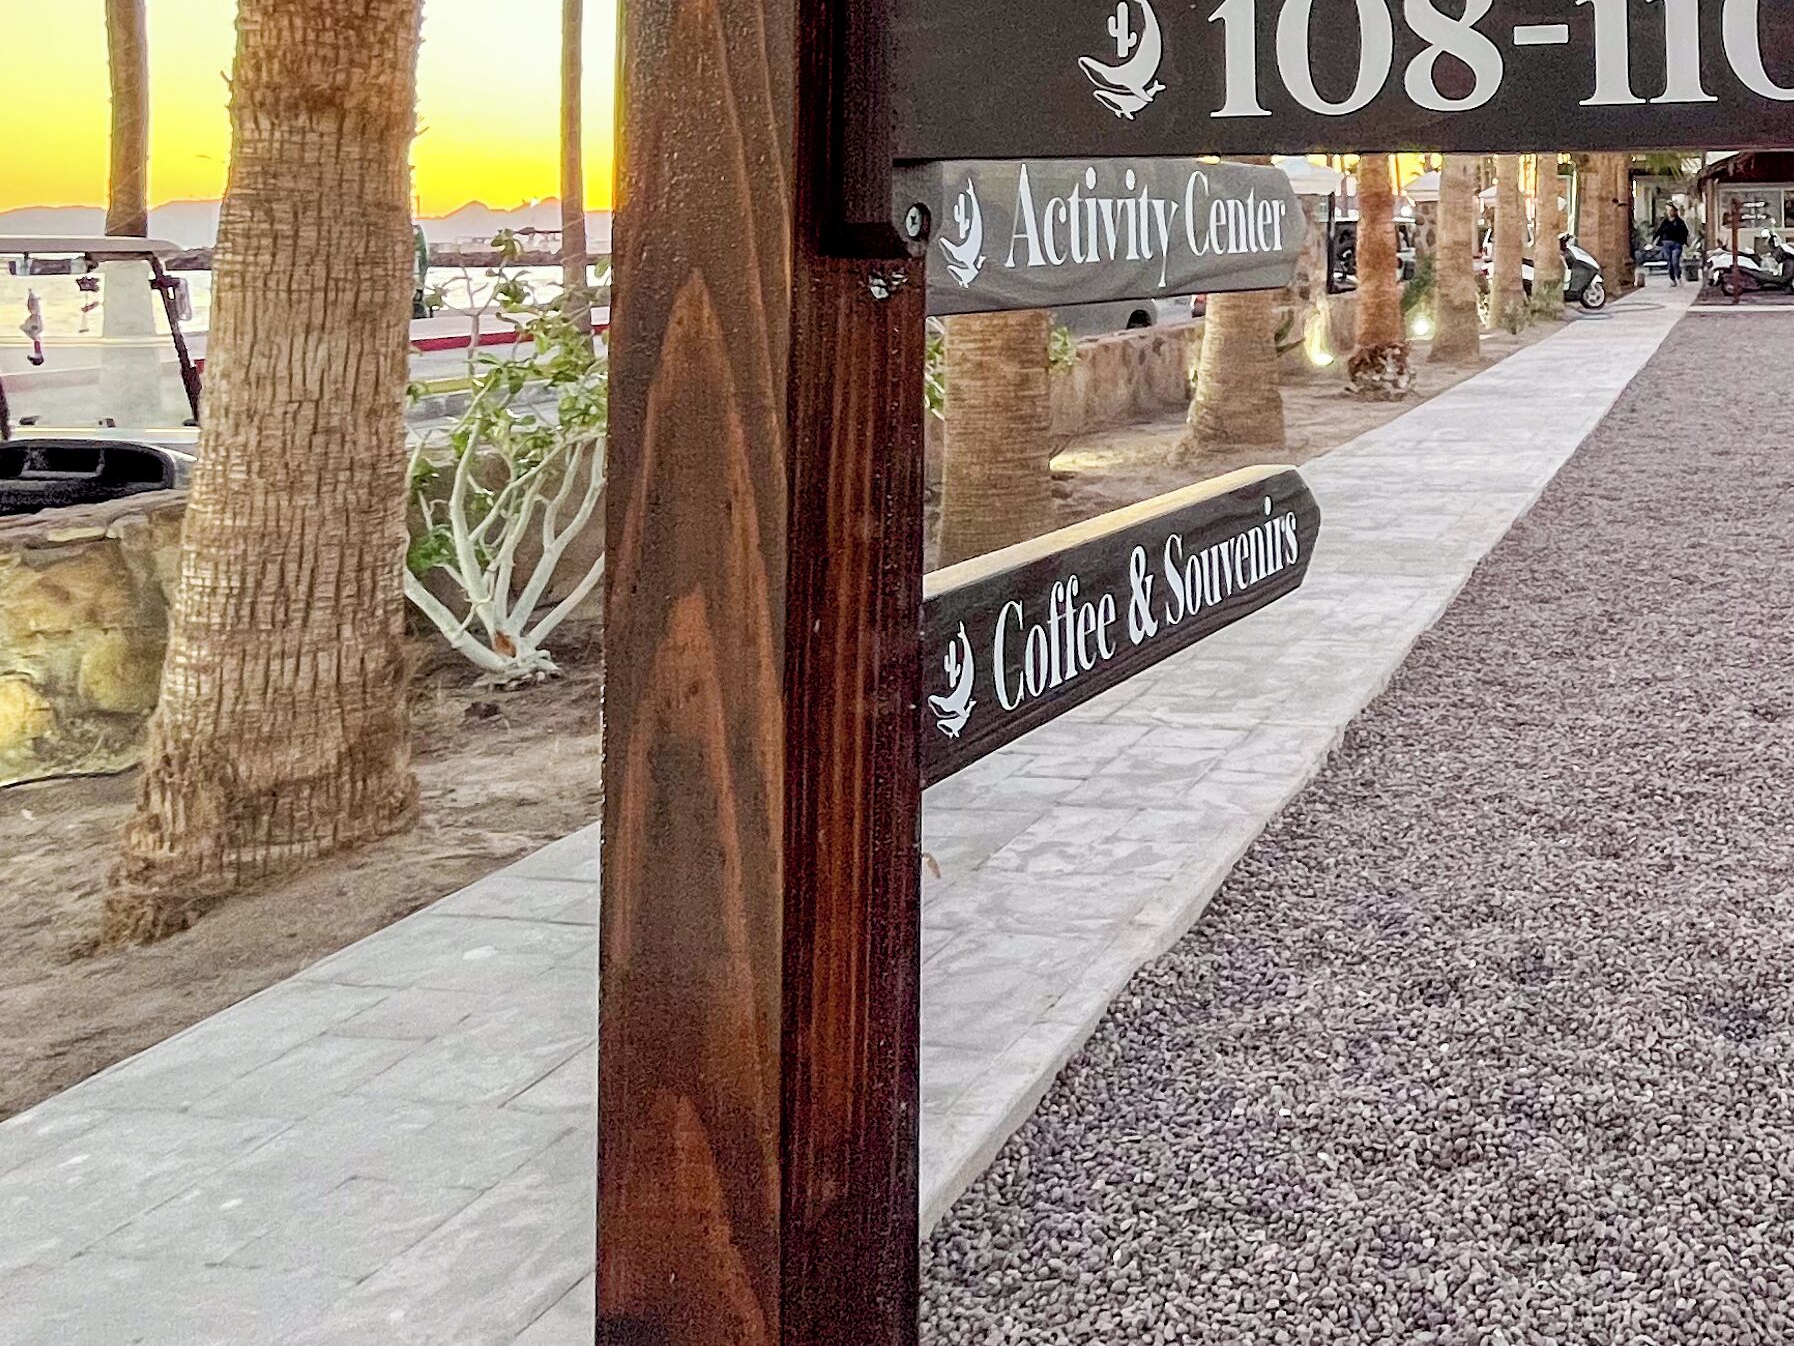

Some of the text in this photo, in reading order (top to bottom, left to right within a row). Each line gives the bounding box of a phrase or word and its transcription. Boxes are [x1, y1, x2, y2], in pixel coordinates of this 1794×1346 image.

[1004, 163, 1286, 288] Activity Center
[994, 496, 1298, 712] Coffee & Souvenirs
